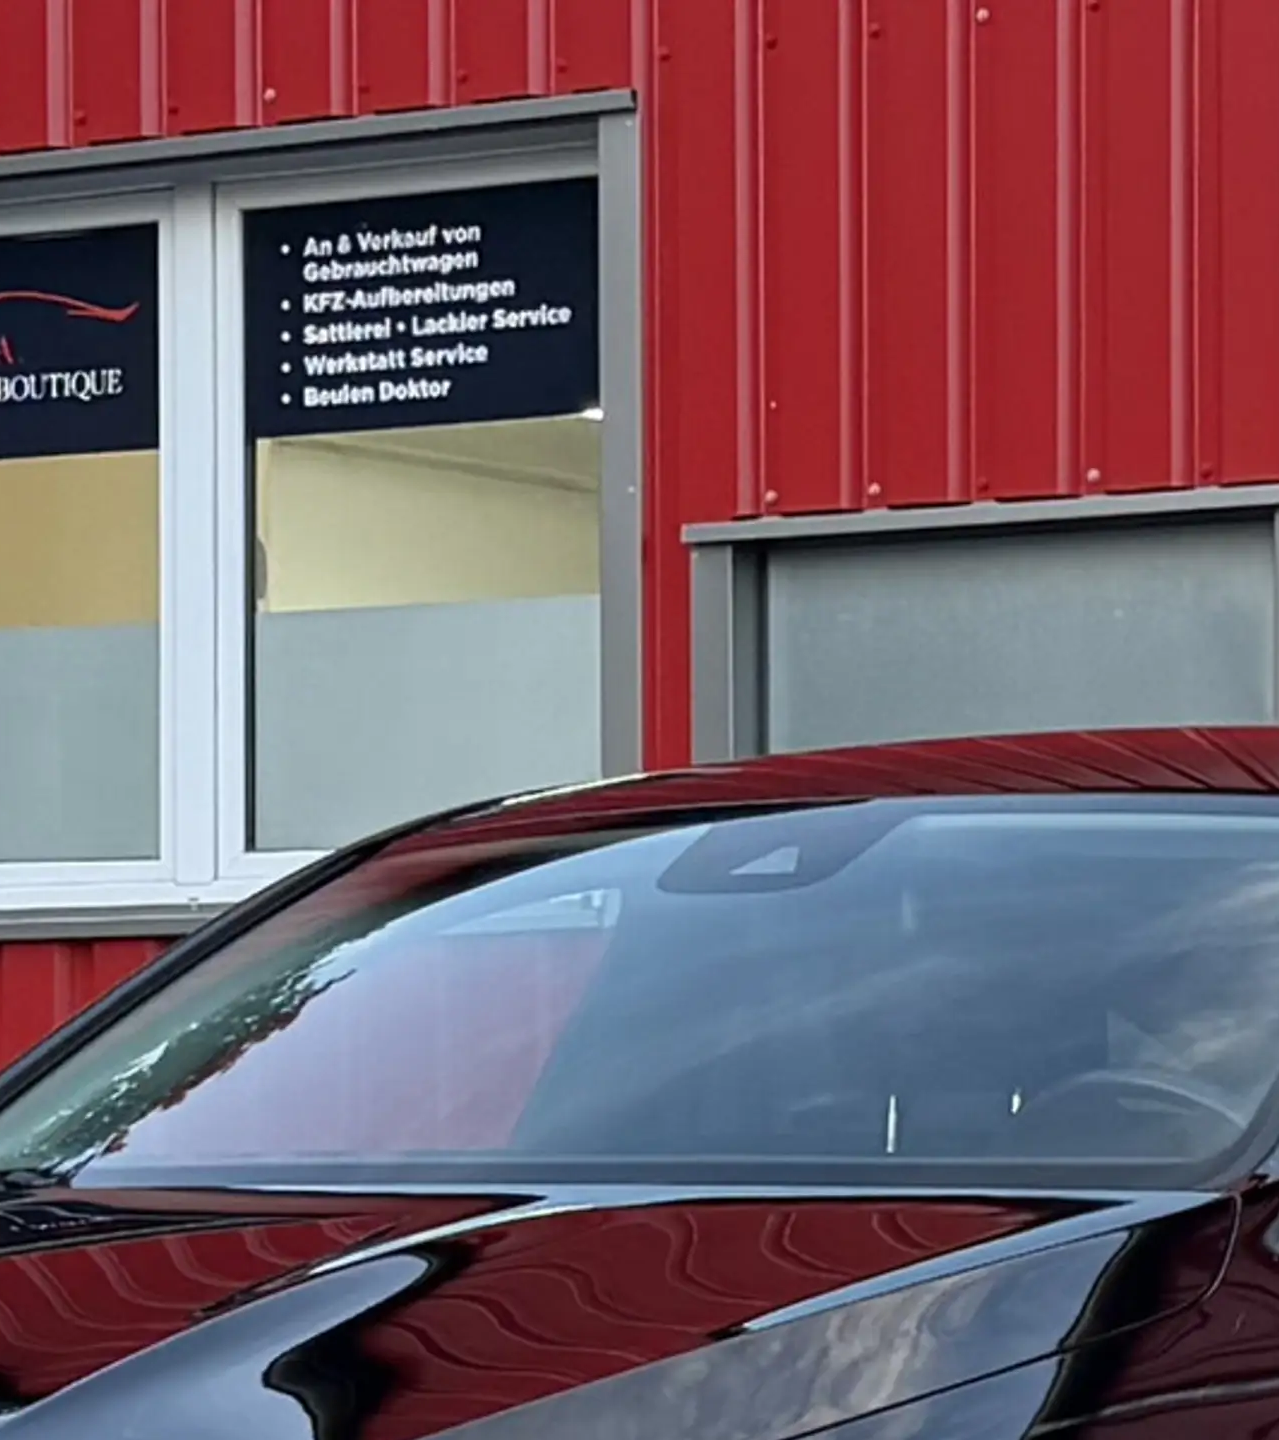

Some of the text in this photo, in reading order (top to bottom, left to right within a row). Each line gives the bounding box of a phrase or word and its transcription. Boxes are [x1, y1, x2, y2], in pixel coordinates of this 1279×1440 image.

[303, 225, 480, 257] An & Verkauf von
[304, 251, 478, 282] Gebrauchtwagen
[304, 280, 515, 313] KFZ-Aufbereitungen
[303, 304, 571, 345] Sattlerei Lackier Service
[304, 343, 488, 375] Werkstatt Service
[304, 378, 451, 406] Beulen Doktor
